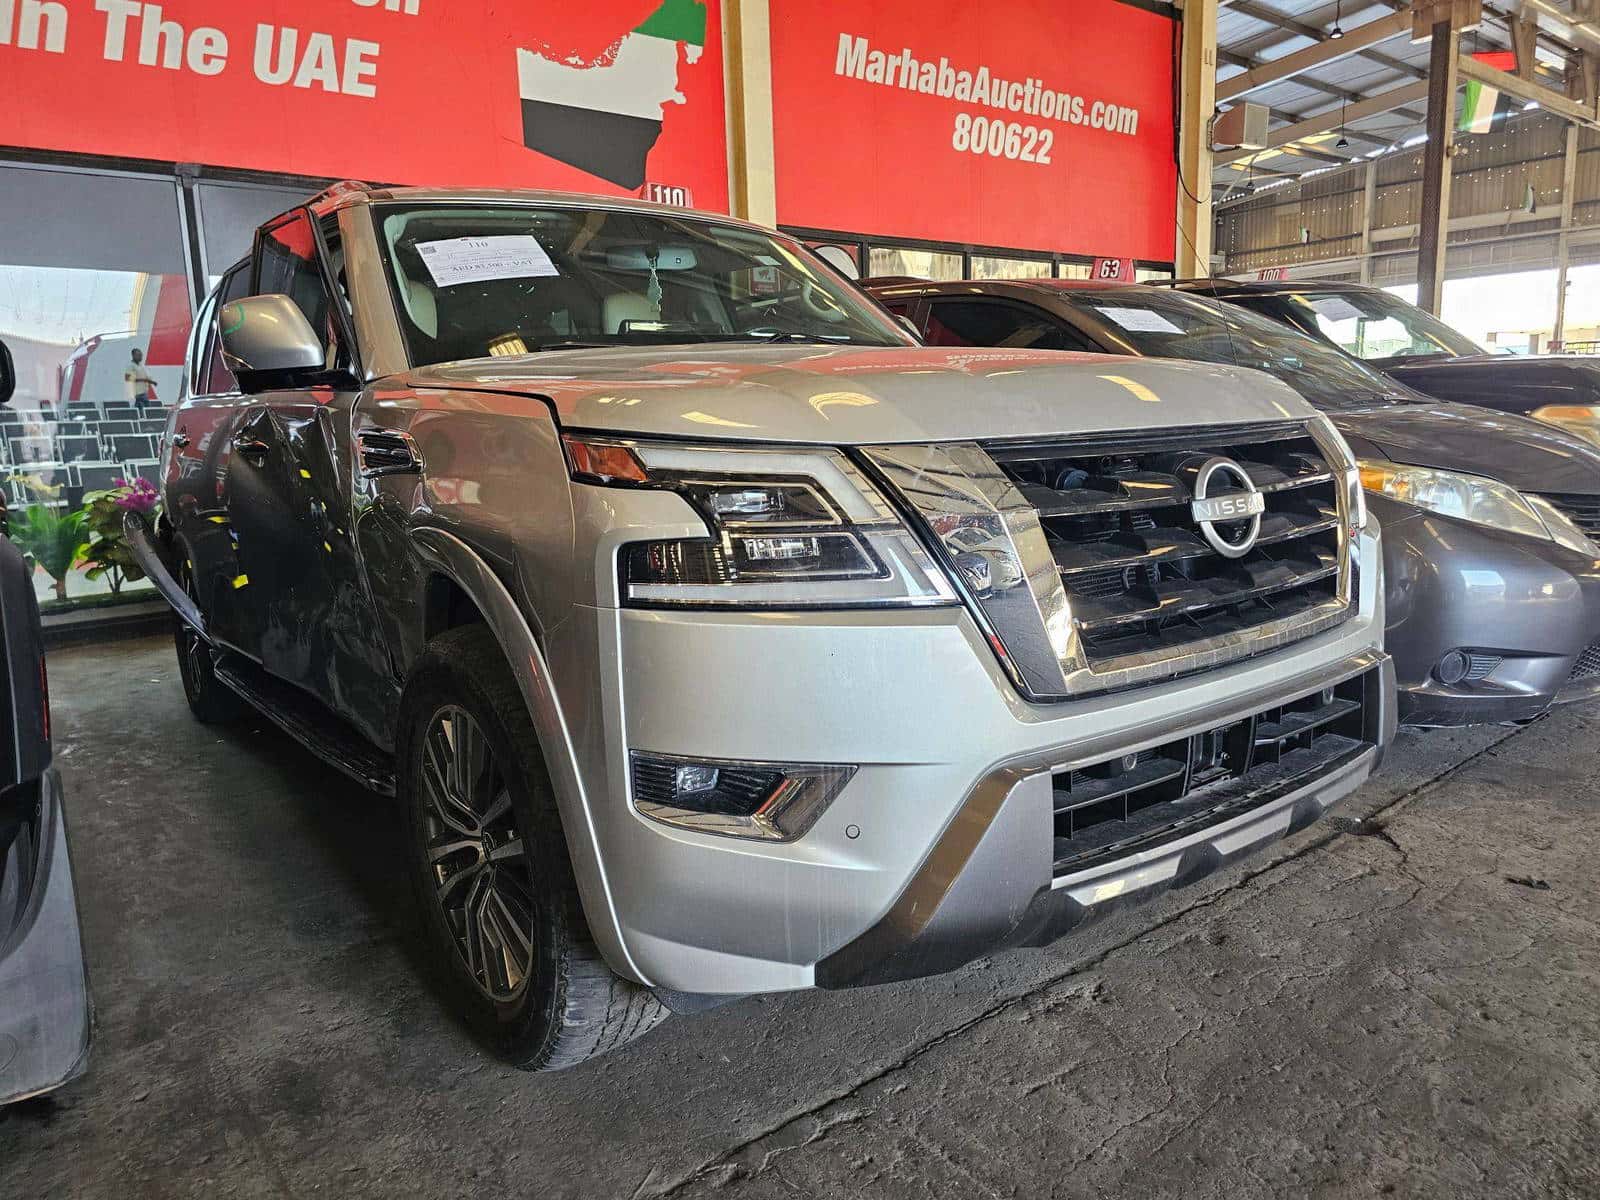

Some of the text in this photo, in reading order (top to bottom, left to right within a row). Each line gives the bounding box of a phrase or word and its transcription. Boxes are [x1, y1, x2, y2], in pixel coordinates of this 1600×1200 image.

[95, 0, 229, 76] The
[253, 23, 380, 98] UAE
[835, 33, 1138, 135] MarhabaAuctions.com
[952, 112, 1054, 165] 800622
[653, 185, 684, 207] 110
[1100, 260, 1120, 278] 63
[1195, 496, 1264, 518] NISS
